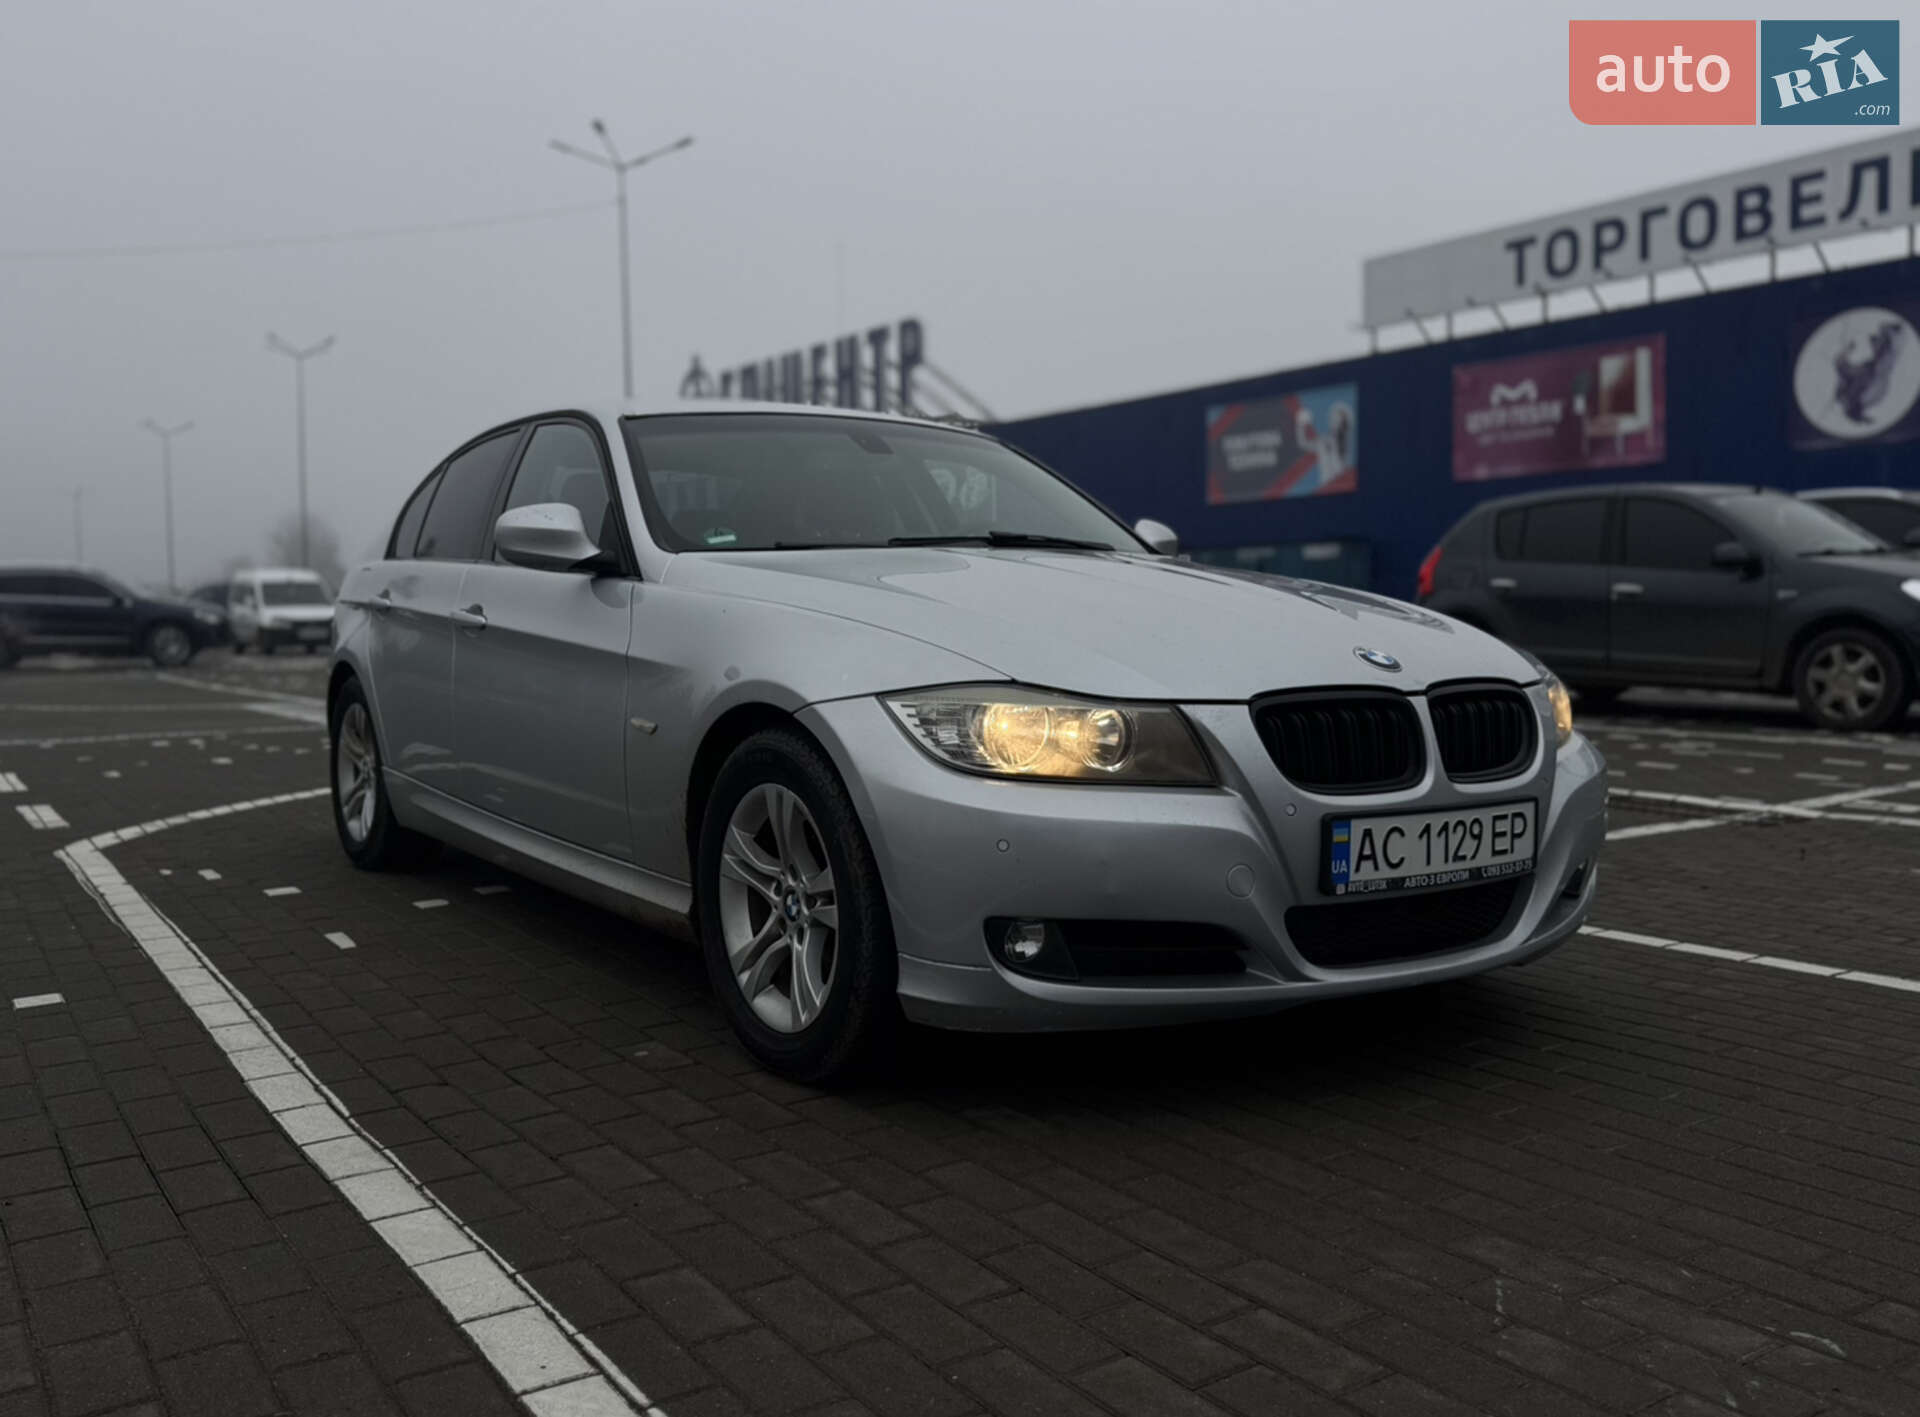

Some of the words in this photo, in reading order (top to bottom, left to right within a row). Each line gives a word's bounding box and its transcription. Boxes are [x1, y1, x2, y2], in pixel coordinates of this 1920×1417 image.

[1504, 146, 1920, 288] ТОРГОВЕЛ
[1331, 859, 1348, 874] UA
[1354, 826, 1406, 873] AC
[1418, 817, 1484, 867] 1129
[1491, 811, 1528, 858] EP
